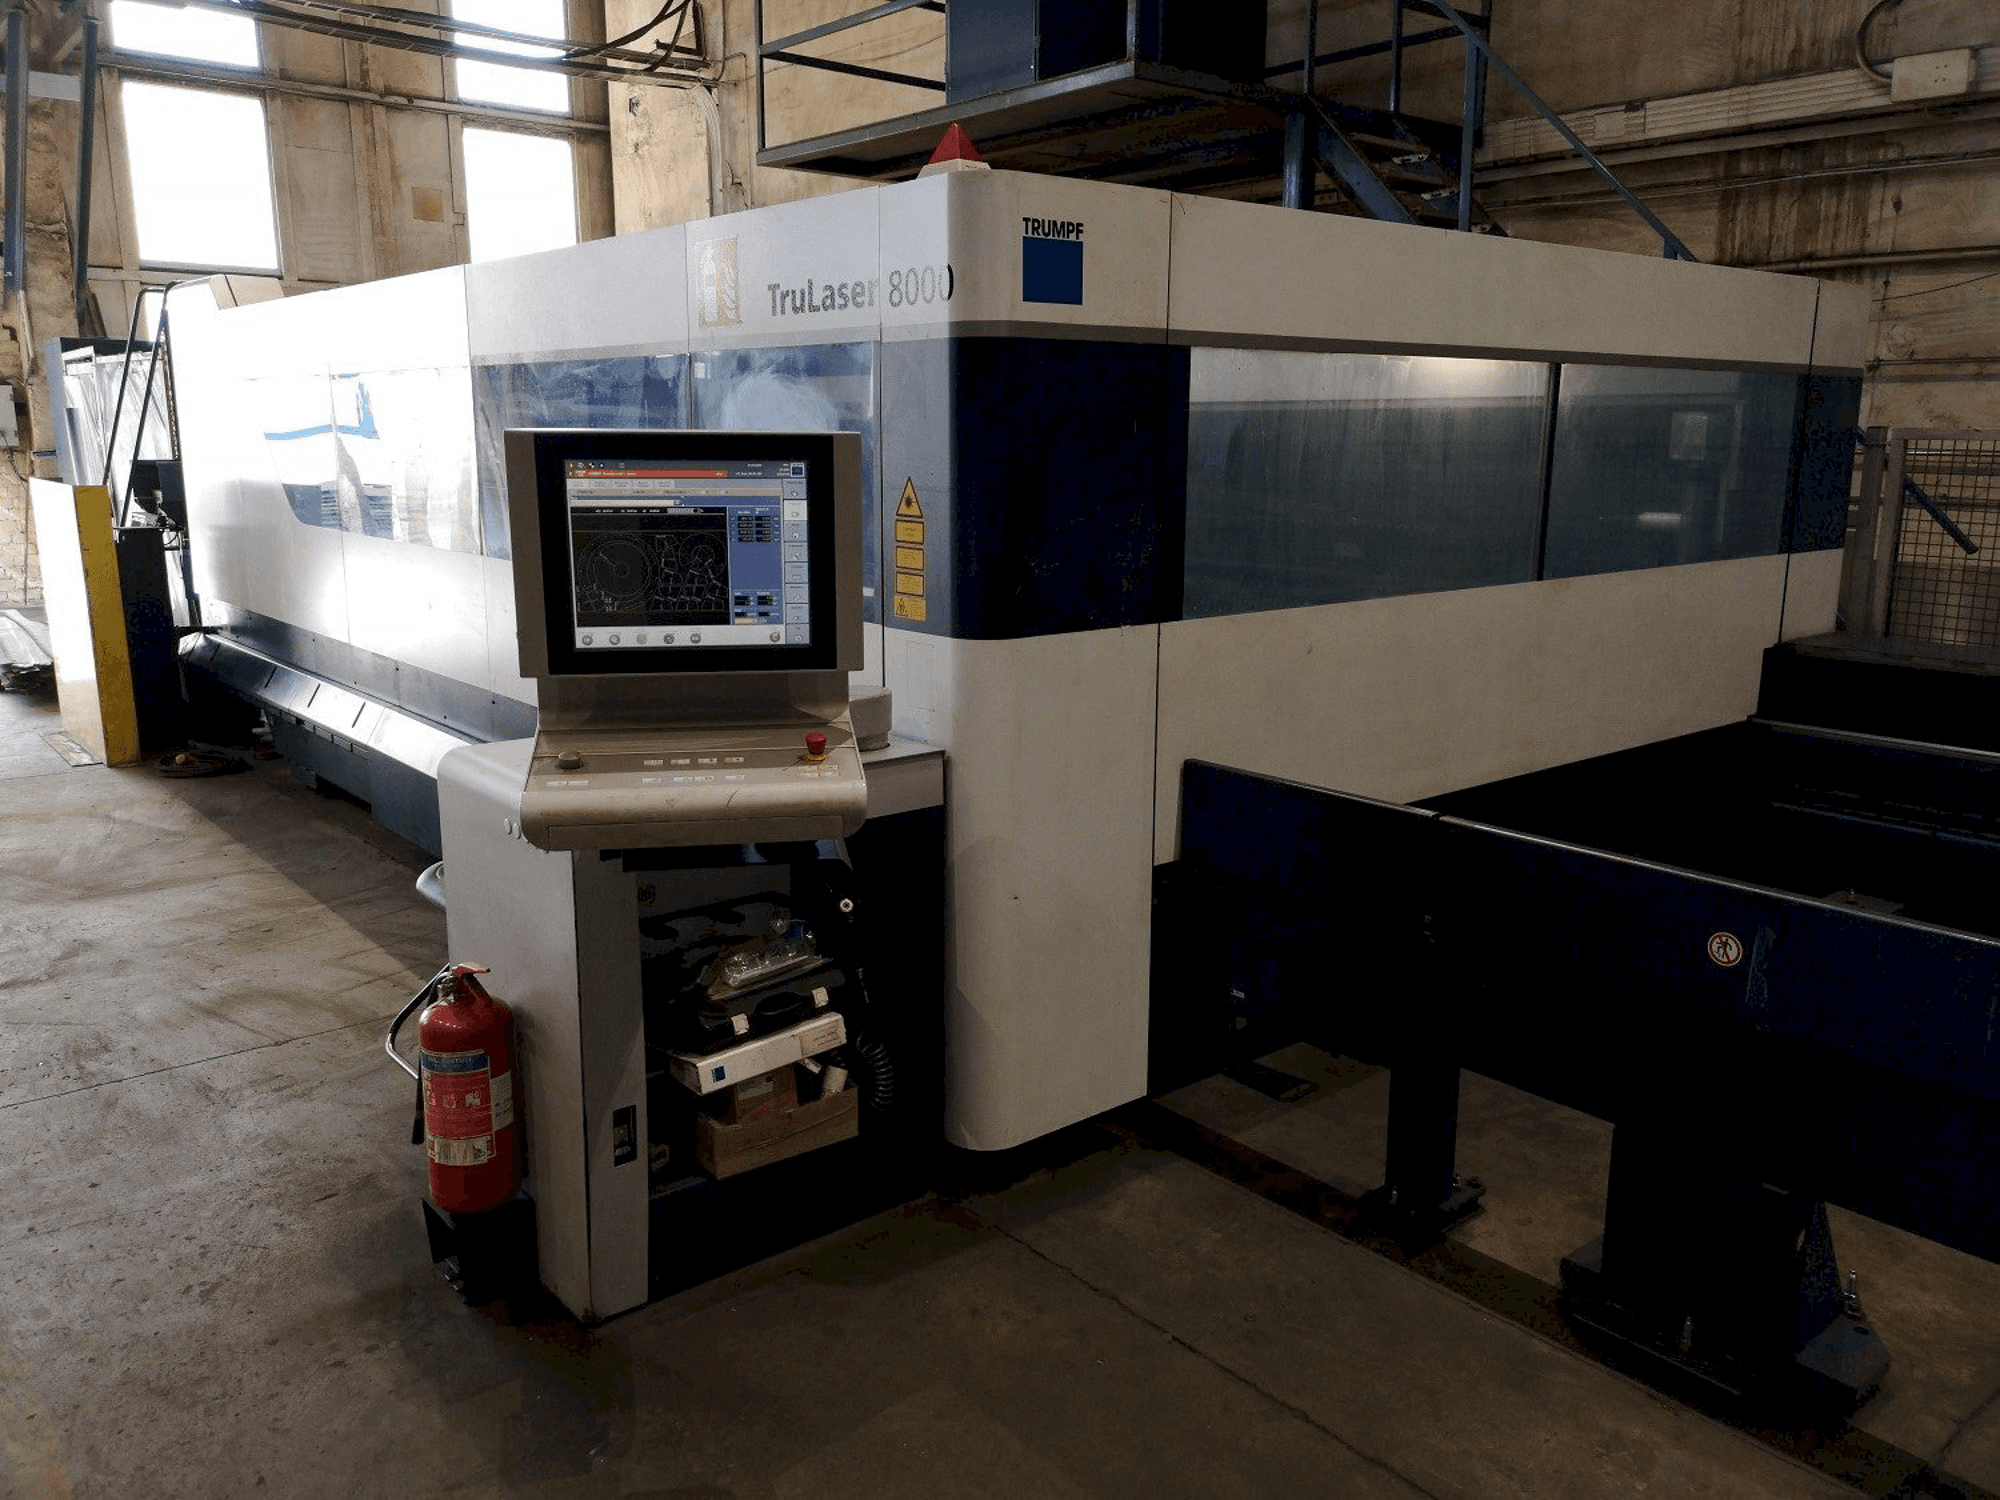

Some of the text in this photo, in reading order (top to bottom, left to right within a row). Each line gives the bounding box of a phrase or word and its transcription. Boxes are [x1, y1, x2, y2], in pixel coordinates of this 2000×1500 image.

[1022, 217, 1084, 240] TRUMPF
[768, 263, 954, 317] TruLaser 8000
